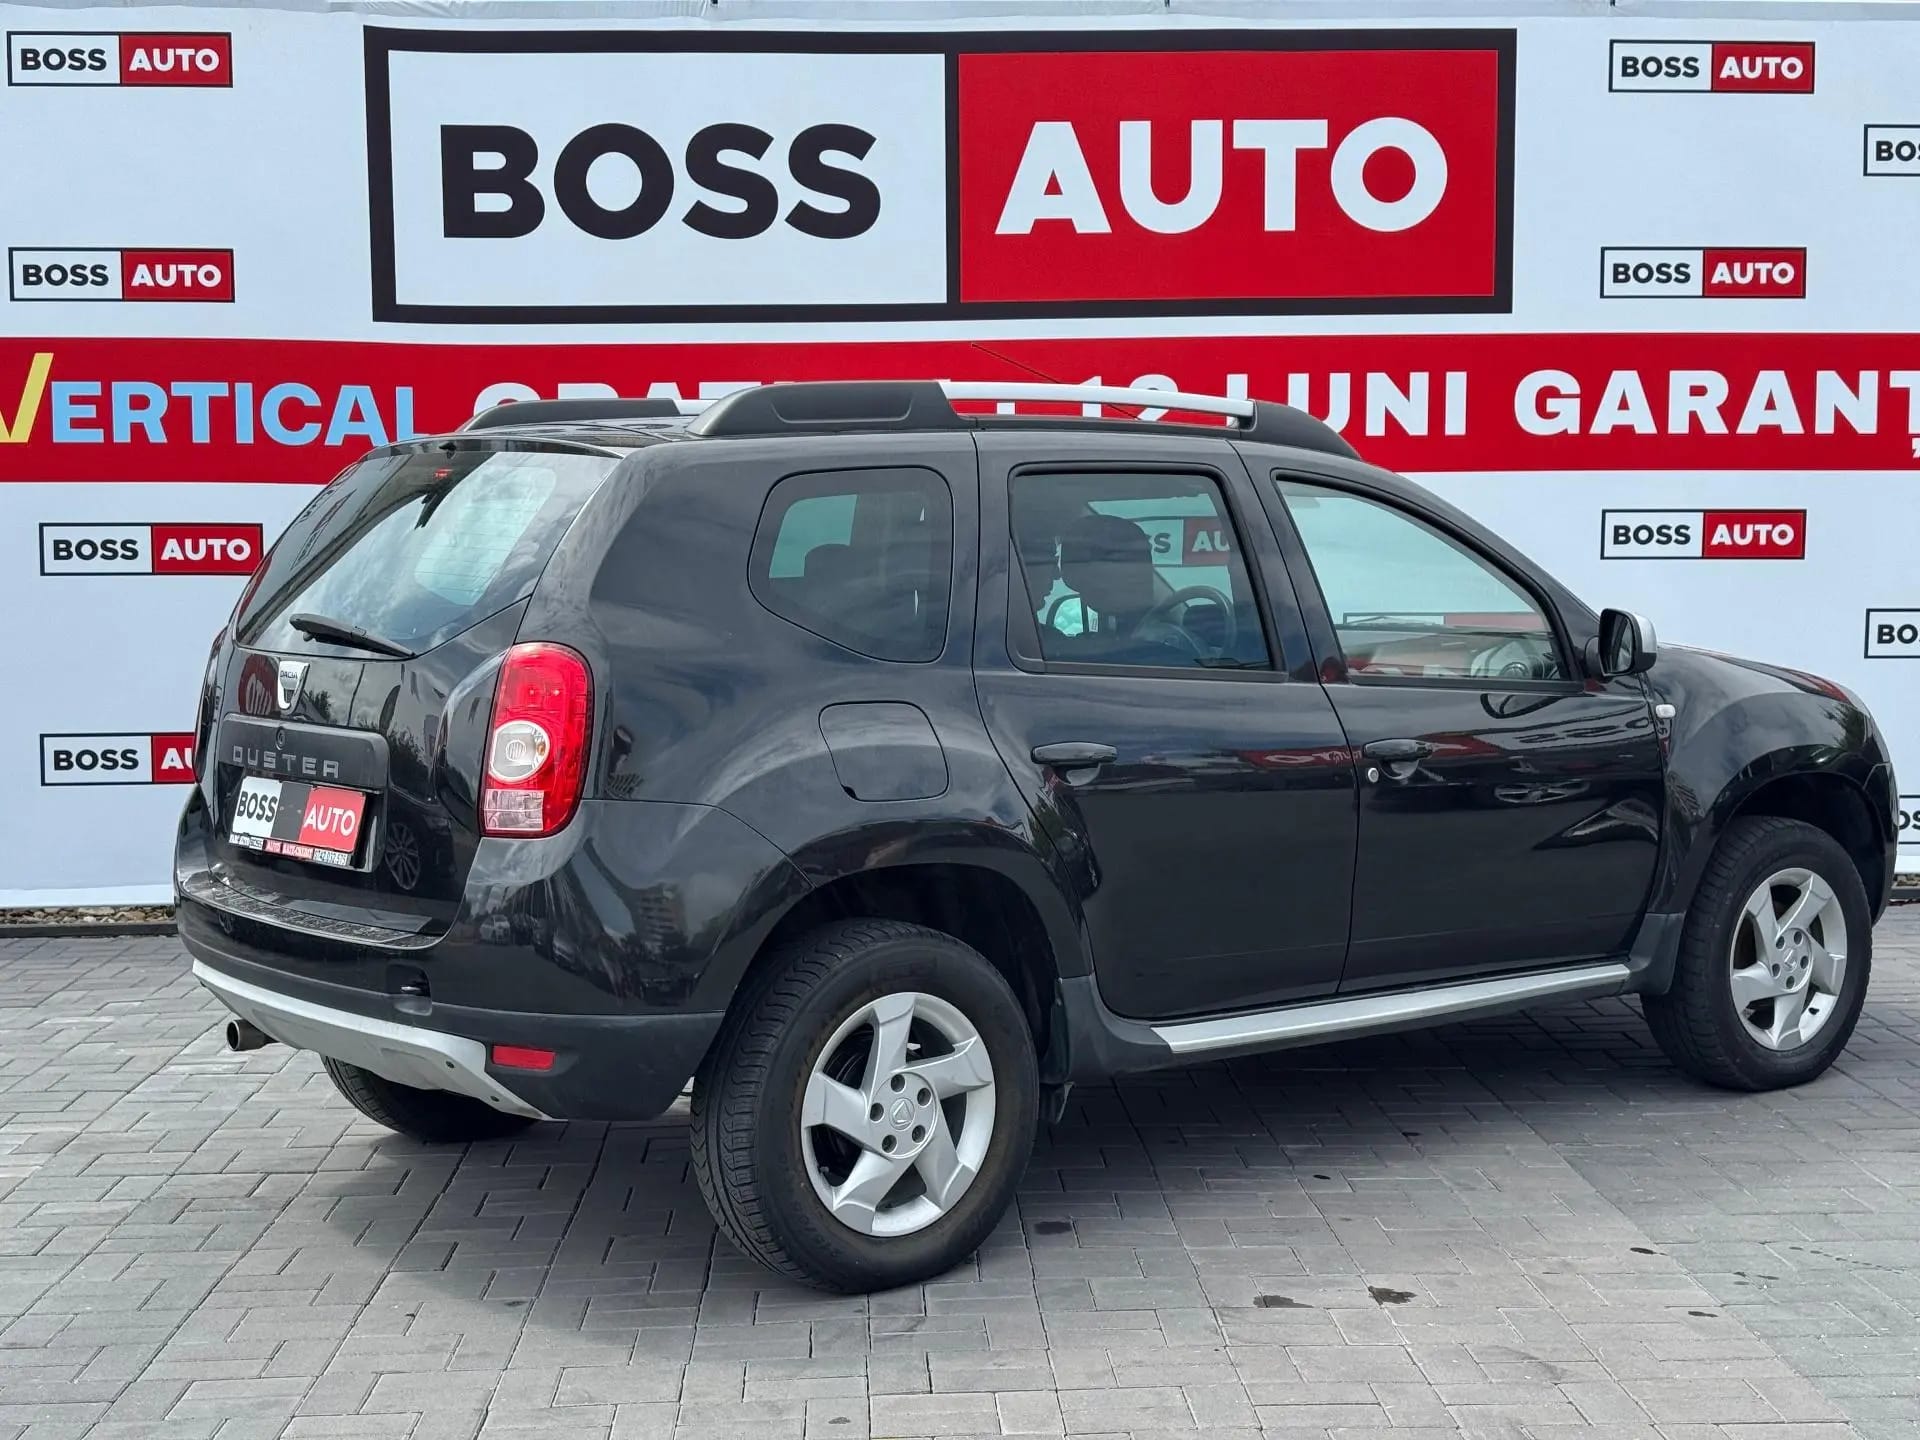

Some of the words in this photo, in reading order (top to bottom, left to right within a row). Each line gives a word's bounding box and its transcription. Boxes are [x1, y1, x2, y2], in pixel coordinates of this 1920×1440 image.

[20, 48, 107, 71] BOSS
[129, 48, 220, 72] AUTO
[1621, 56, 1700, 78] BOSS
[1719, 56, 1804, 80] AUTO
[1875, 140, 1920, 162] BO
[441, 123, 881, 240] BOSS
[995, 117, 1448, 235] AUTO
[22, 263, 109, 287] BOSS
[131, 263, 222, 288] AUTO
[1612, 262, 1691, 284] BOSS
[1711, 262, 1795, 285] AUTO
[1613, 524, 1691, 545] BOSS
[1710, 523, 1795, 546] AUTO
[53, 538, 139, 561] BOSS
[160, 538, 251, 561] AUTO
[1877, 623, 1920, 645] BO
[53, 748, 139, 771] BOSS
[232, 745, 339, 779] DUSTER
[236, 790, 278, 823] BOSS
[303, 803, 356, 837] AUTO
